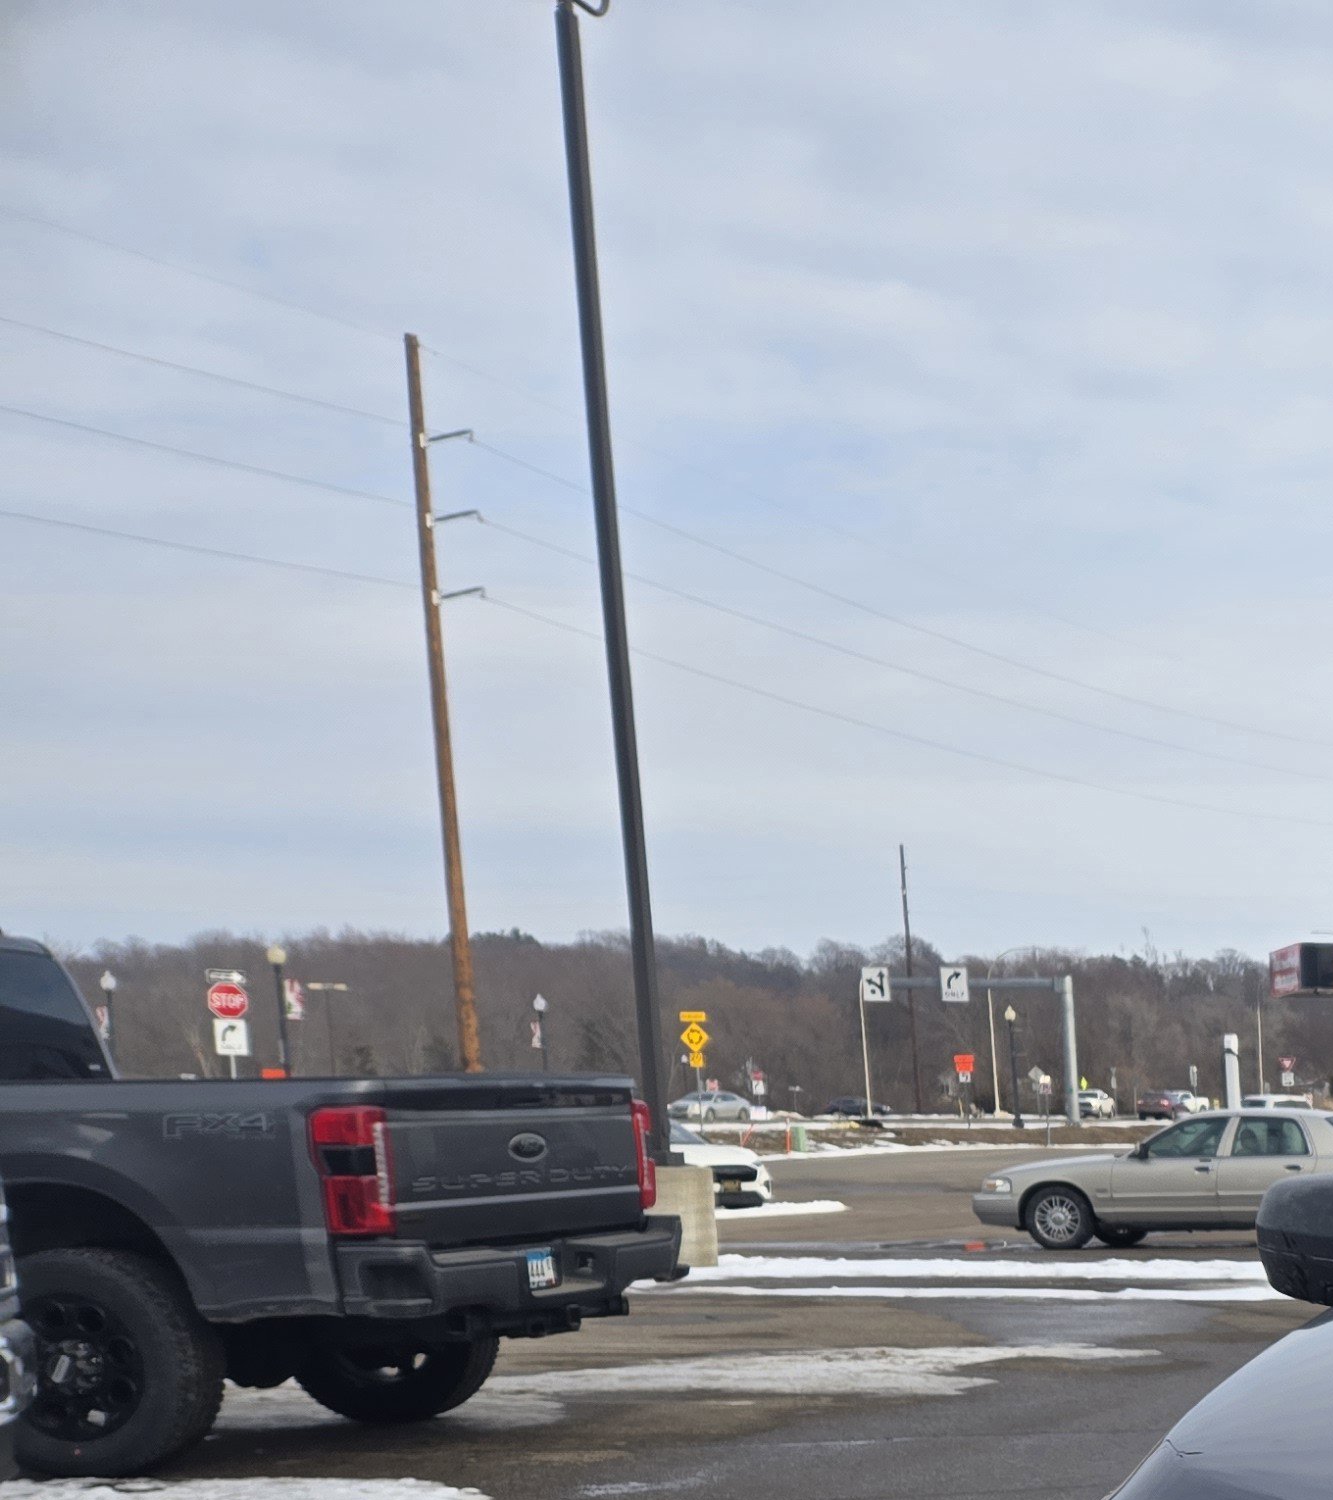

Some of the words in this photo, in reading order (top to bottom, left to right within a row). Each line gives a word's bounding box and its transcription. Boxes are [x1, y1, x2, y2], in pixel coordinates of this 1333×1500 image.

[210, 992, 244, 1008] STOP
[412, 1170, 542, 1192] SUPER
[549, 1164, 629, 1183] DUTY
